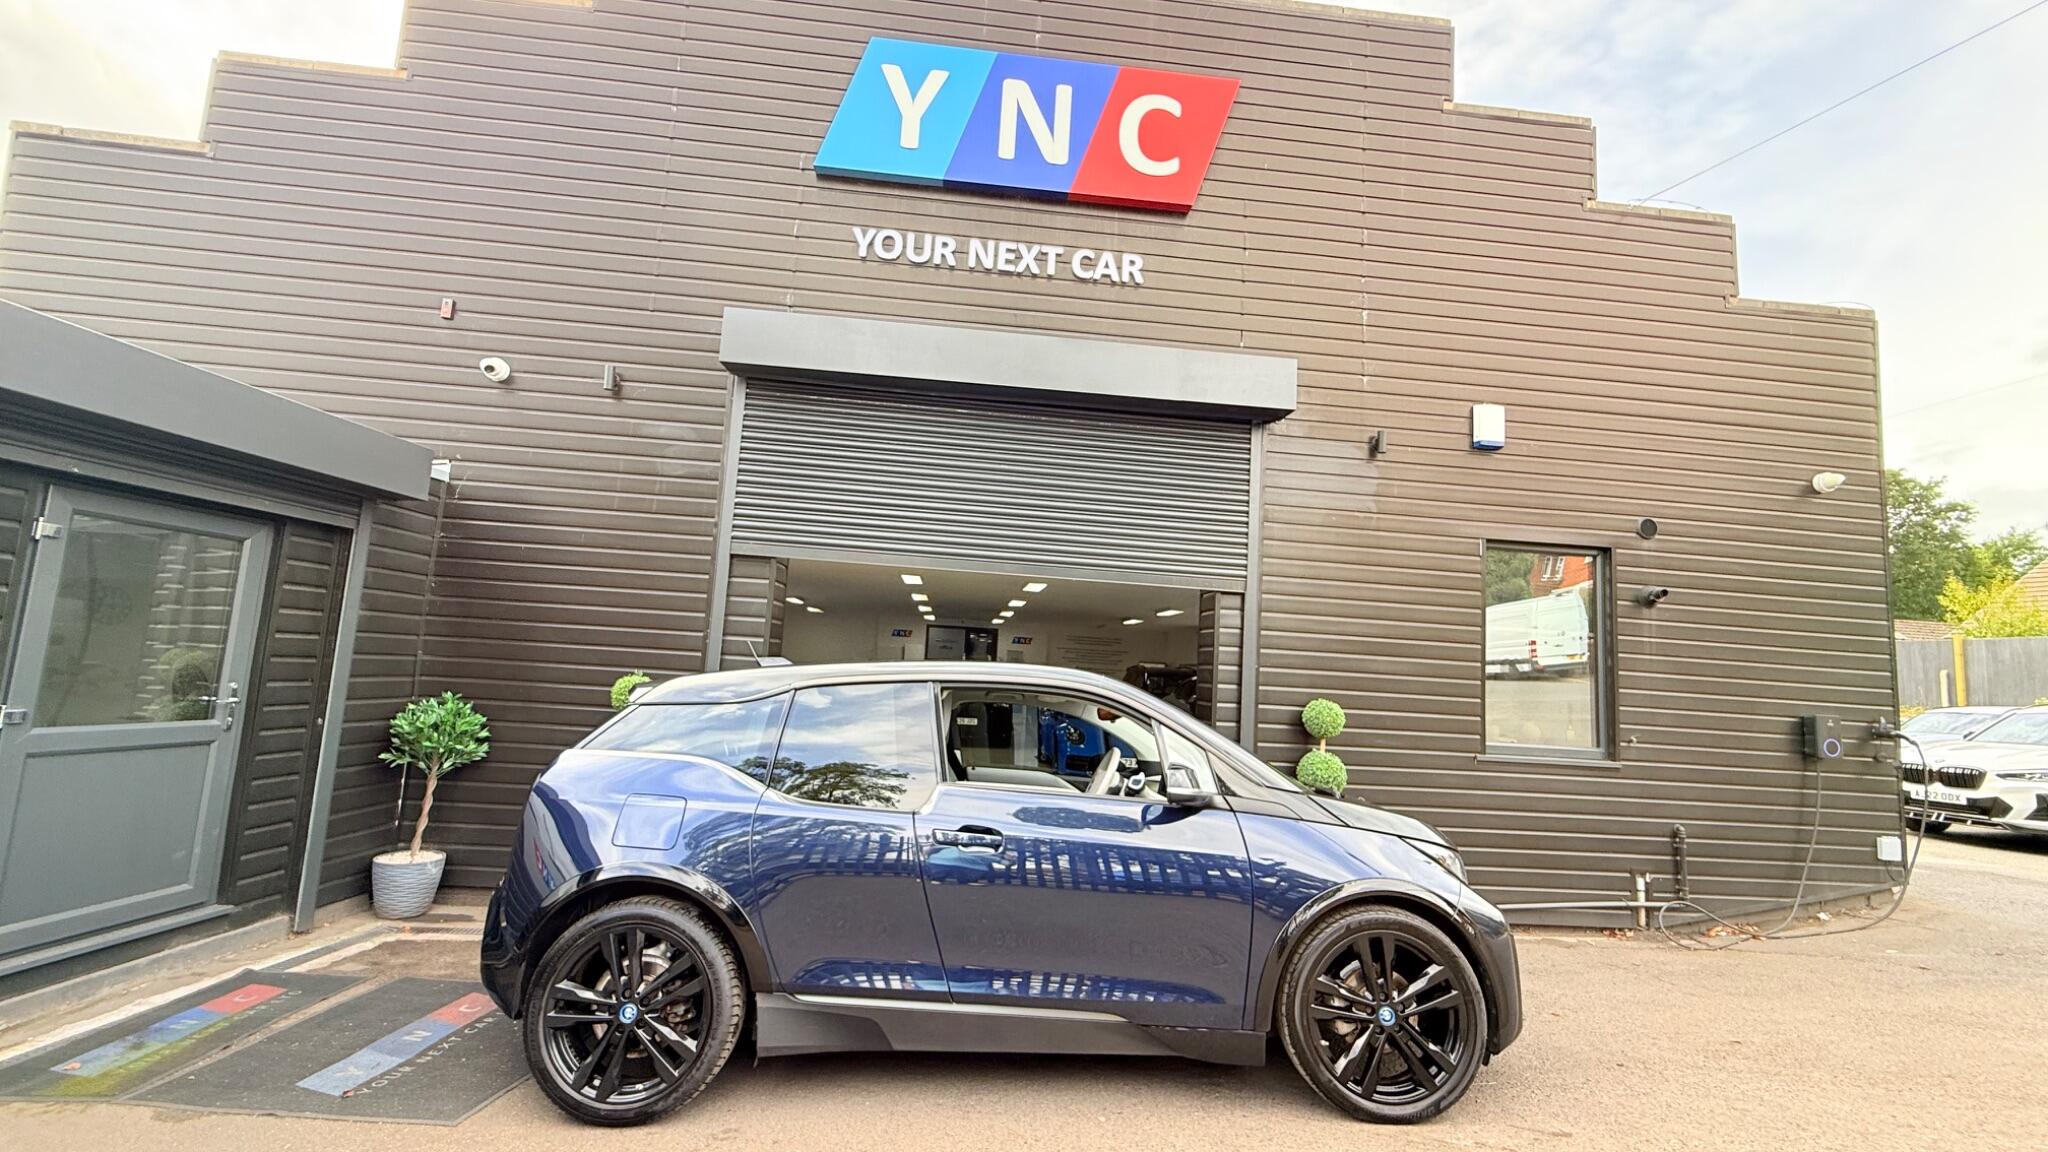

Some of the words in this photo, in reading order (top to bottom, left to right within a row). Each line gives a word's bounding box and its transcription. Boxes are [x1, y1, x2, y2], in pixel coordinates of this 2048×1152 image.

[881, 63, 1182, 177] YNC
[852, 227, 957, 267] YOUR
[968, 238, 1063, 276] NEXT
[1071, 249, 1144, 285] CAR
[356, 1065, 416, 1095] YOUR
[416, 1035, 462, 1063] NEXT
[464, 1016, 498, 1034] CAR
